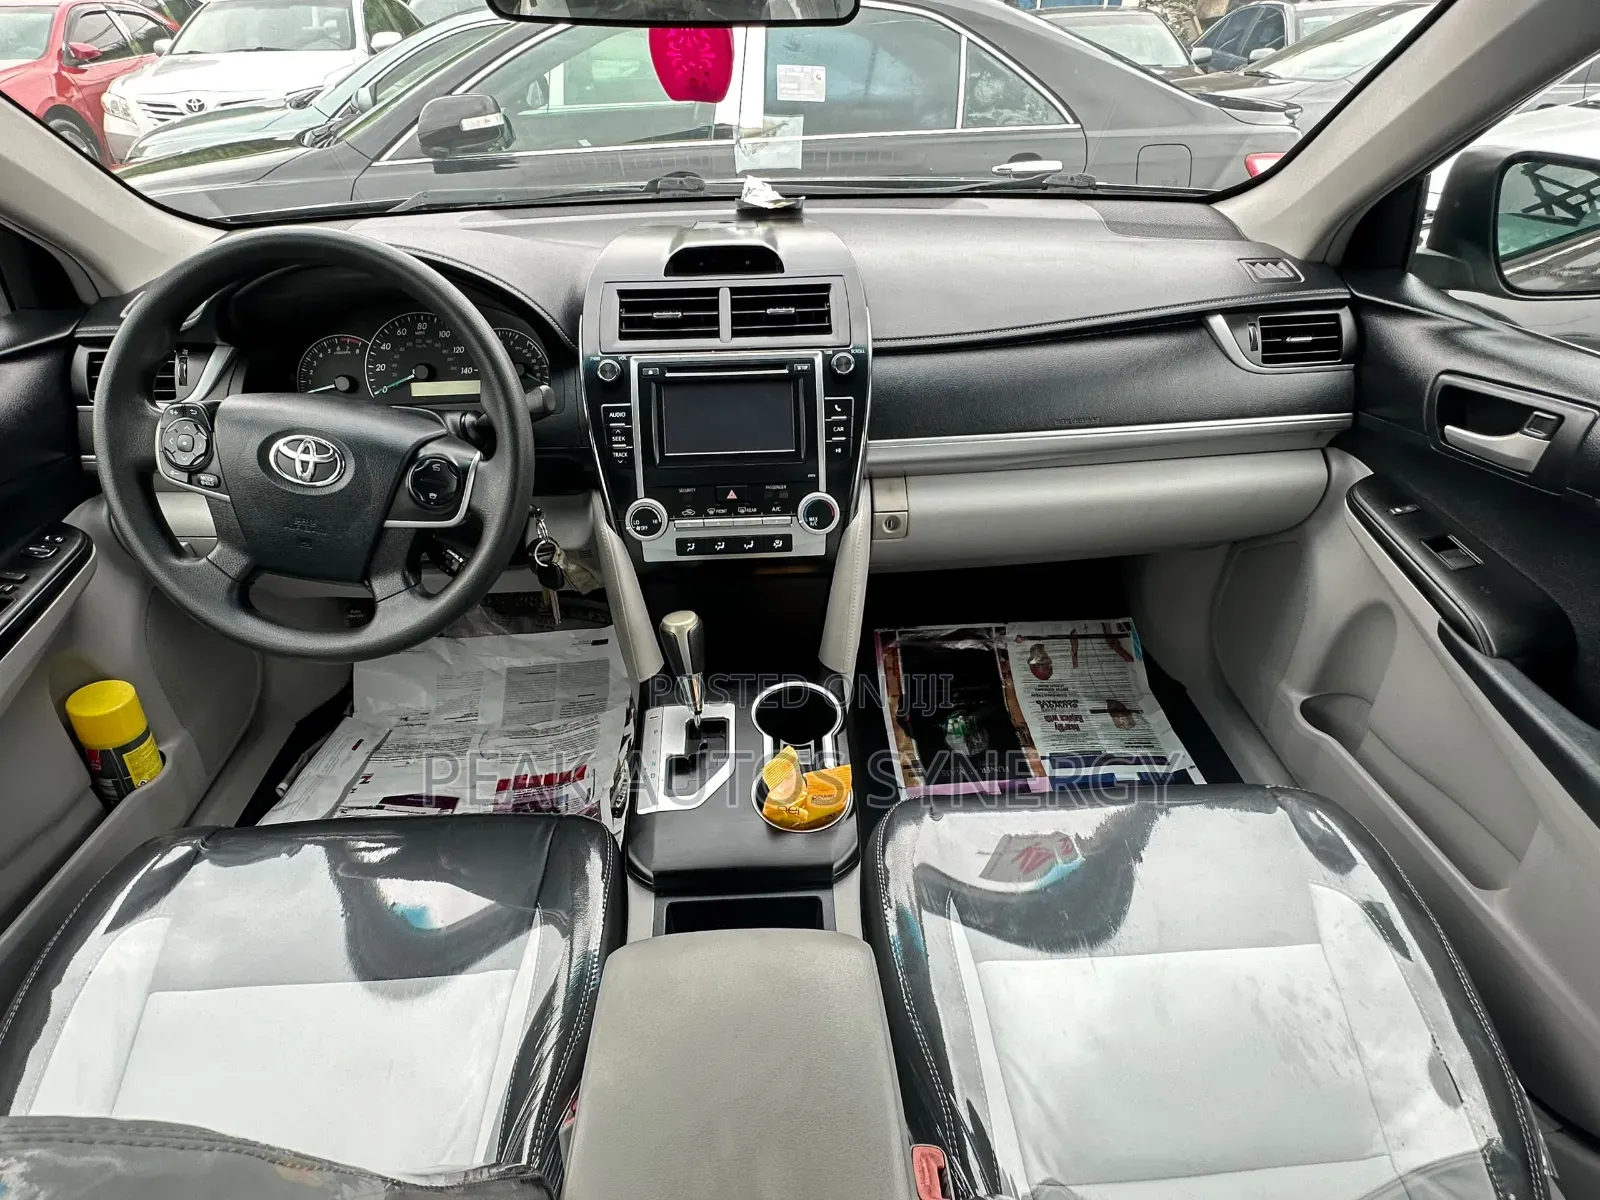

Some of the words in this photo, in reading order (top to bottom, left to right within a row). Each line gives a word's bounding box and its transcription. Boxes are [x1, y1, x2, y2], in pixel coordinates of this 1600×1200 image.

[417, 322, 428, 330] 80
[396, 328, 407, 336] 60
[438, 330, 451, 338] 100
[380, 342, 391, 350] 40
[453, 346, 465, 354] 120
[375, 363, 386, 371] 20
[460, 366, 473, 374] 140
